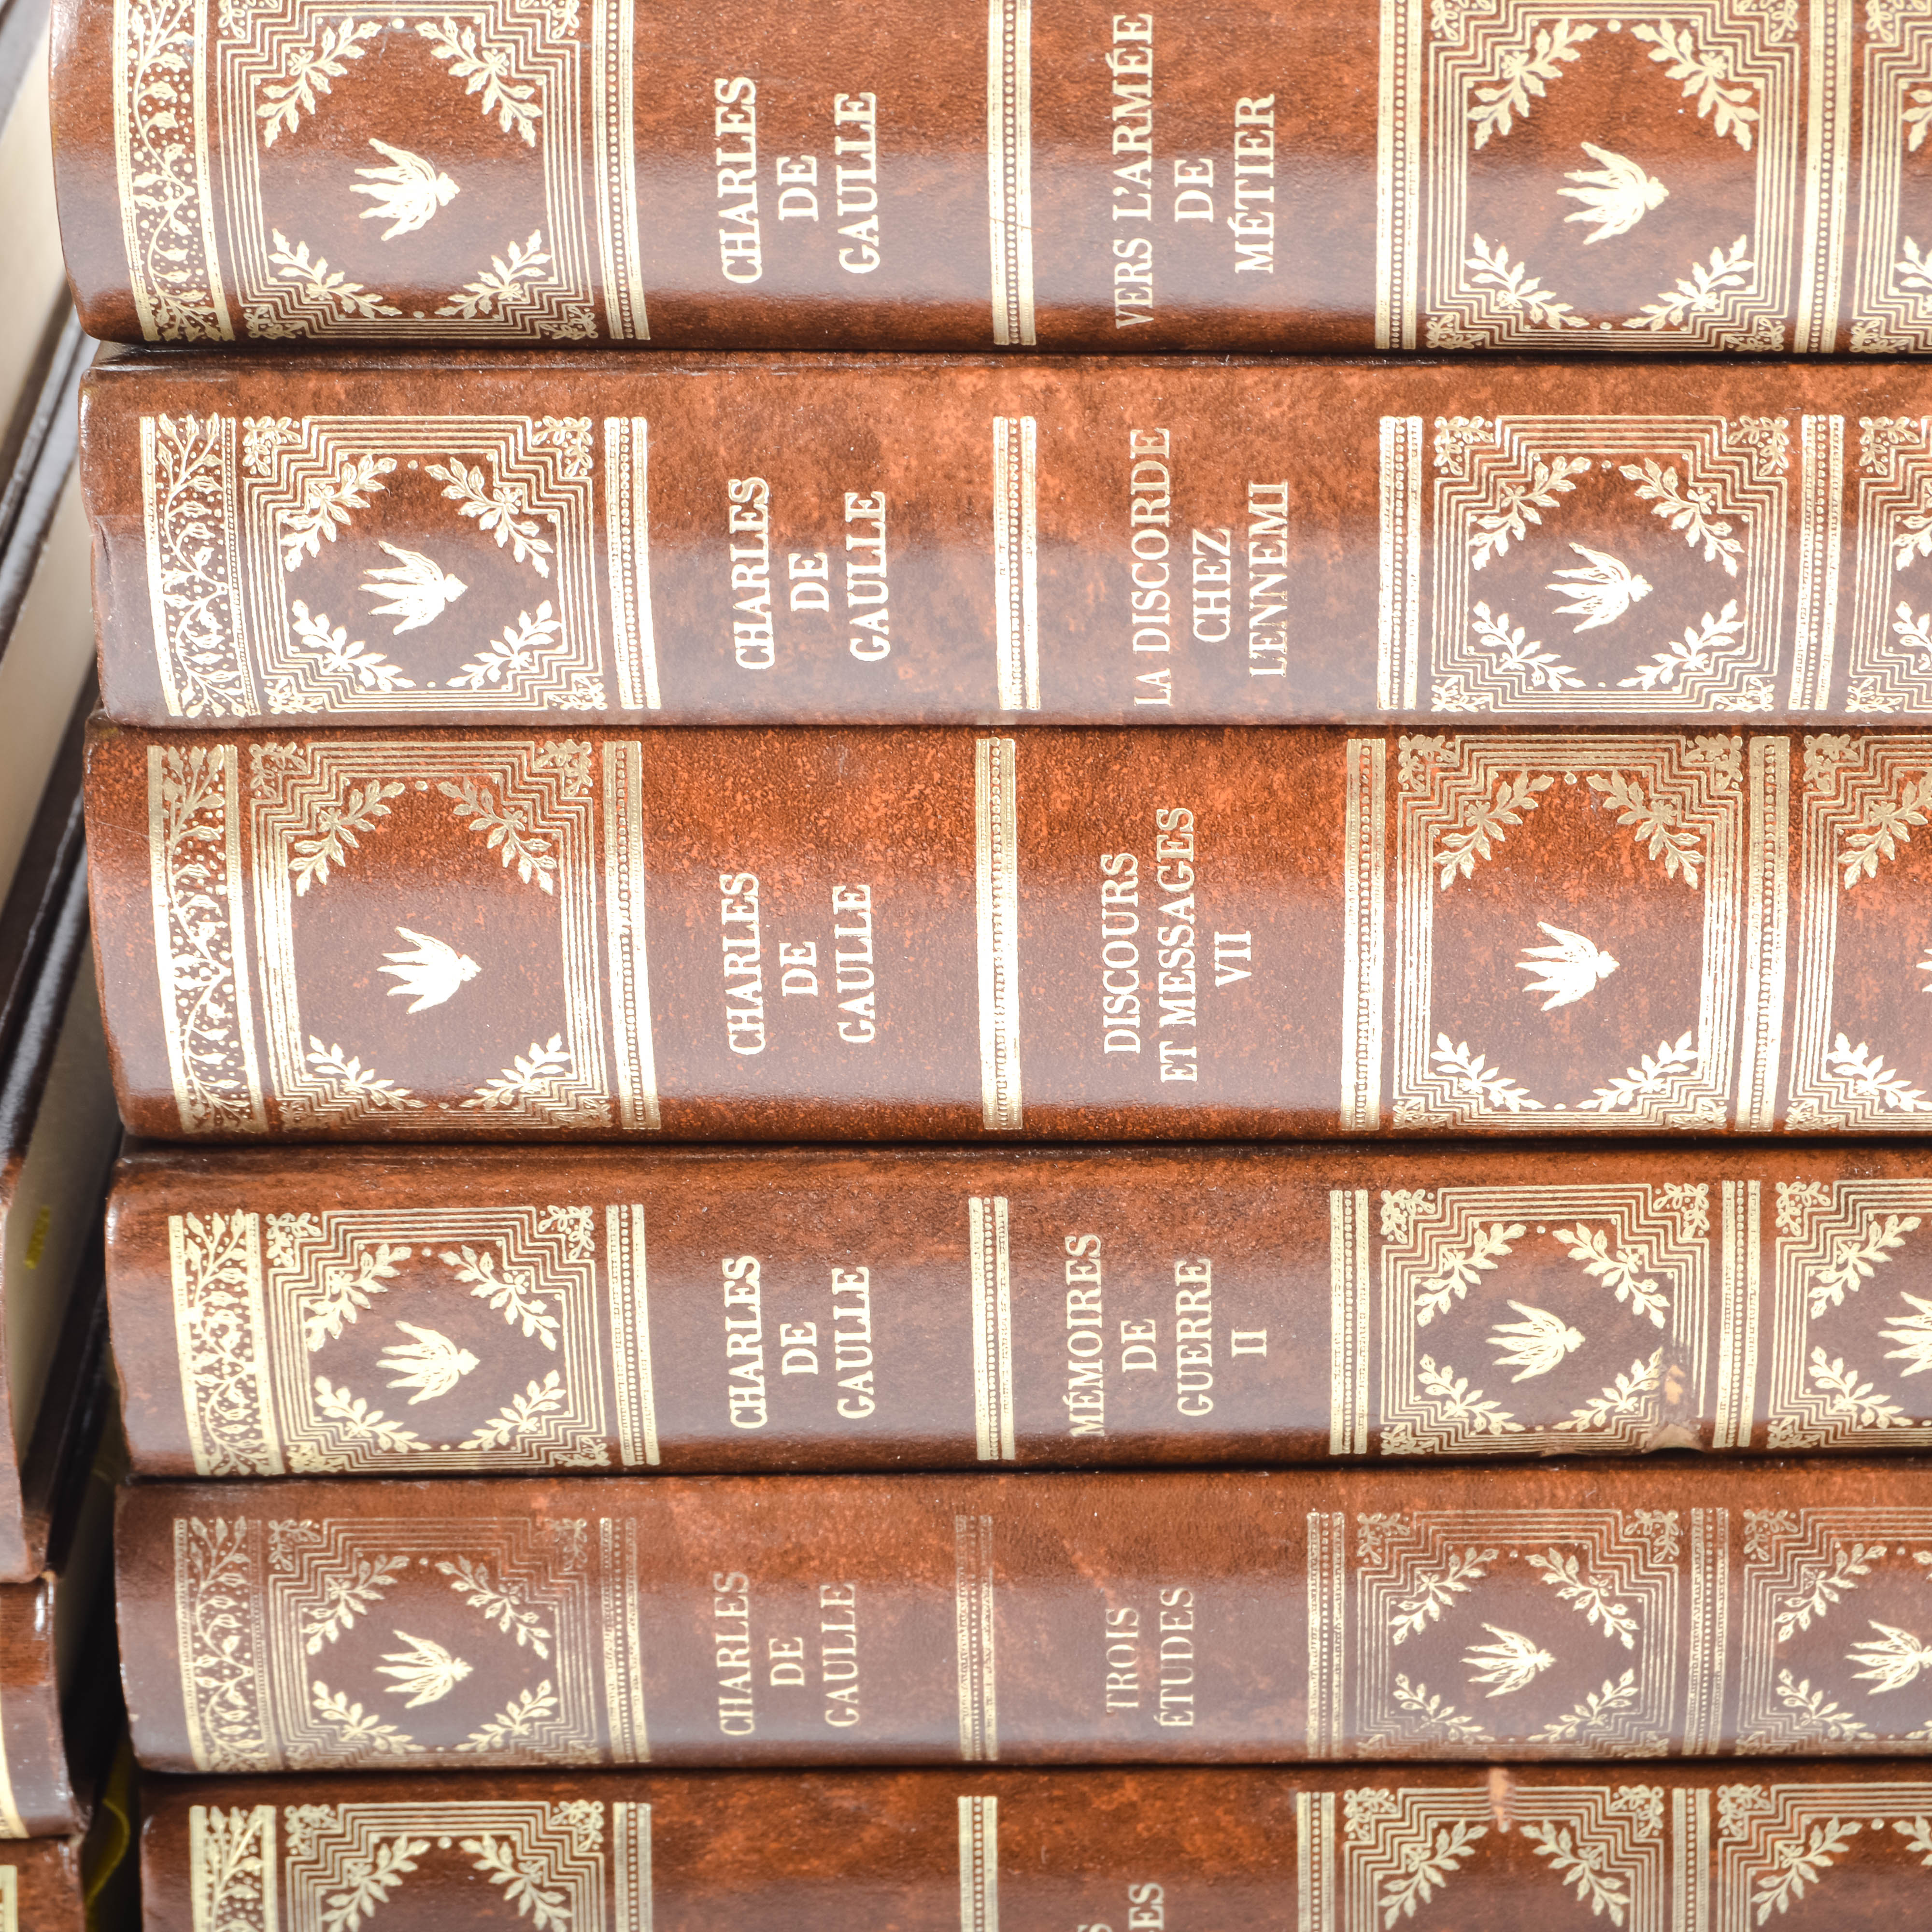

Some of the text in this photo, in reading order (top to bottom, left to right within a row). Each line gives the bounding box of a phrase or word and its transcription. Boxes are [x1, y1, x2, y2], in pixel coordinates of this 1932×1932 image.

[714, 78, 762, 284] CHARLES
[778, 155, 819, 221] DE
[834, 92, 881, 274] GAULLE
[1105, 14, 1154, 329] VERS L'ARMÉE
[1174, 158, 1214, 223] DE
[1227, 93, 1275, 273] MÉTIER
[728, 477, 774, 670] CHARLES
[788, 553, 830, 612] DE
[844, 491, 890, 662] GAULLE
[1130, 428, 1171, 706] LA DISCORDE
[1192, 528, 1232, 643] CHEZ
[1248, 481, 1288, 678] L'ENNEMI
[720, 873, 765, 1055] CHARLES
[779, 941, 818, 996] DE
[832, 884, 875, 1044] GAULLE
[1101, 852, 1140, 1053] DISCOURS
[1156, 808, 1198, 1082] ET MESSAGES
[1214, 930, 1251, 987] VII
[722, 1257, 767, 1429] CHARLES
[780, 1322, 819, 1376] DE
[831, 1266, 875, 1420] GAULLE
[1064, 1234, 1106, 1436] MÉMOIRES
[1121, 1319, 1157, 1372] DE
[1174, 1259, 1213, 1417] GUERRE
[1231, 1329, 1267, 1357] II
[714, 1571, 756, 1736] CHARLES
[768, 1637, 805, 1687] DE
[820, 1583, 858, 1728] GAULLE
[1105, 1607, 1139, 1713] TROIS
[1154, 1588, 1194, 1728] ÉTUDES
